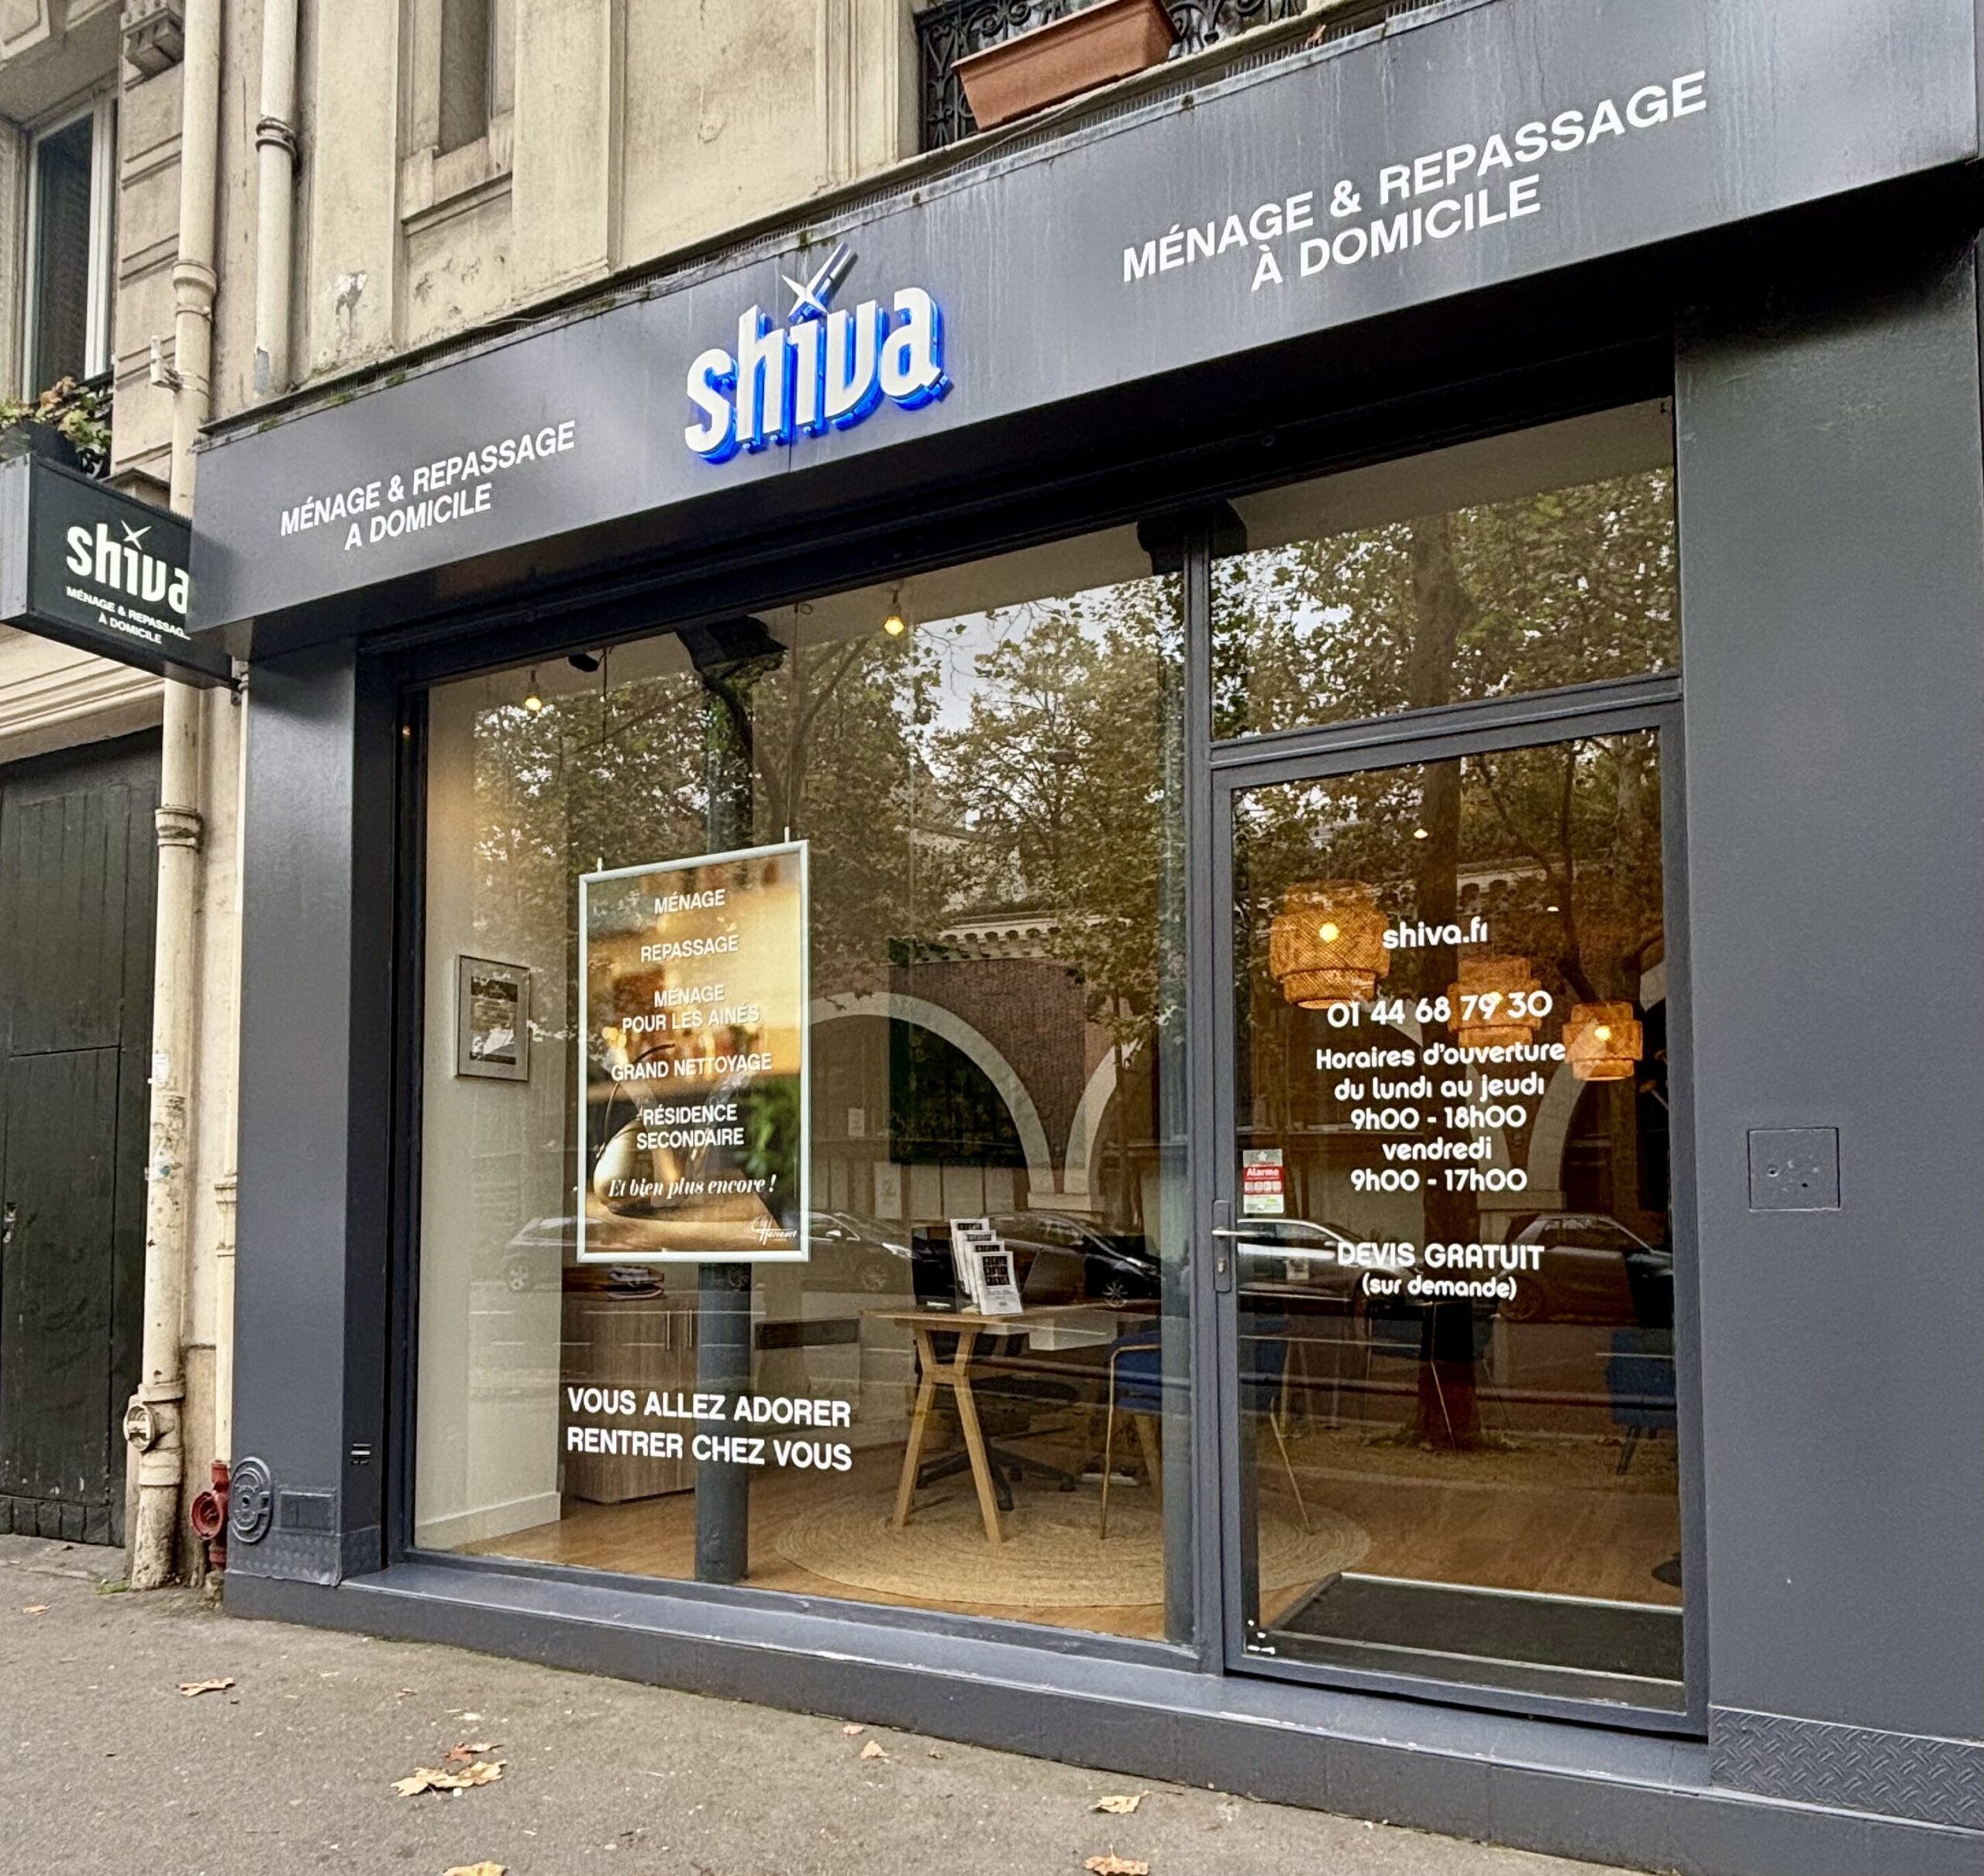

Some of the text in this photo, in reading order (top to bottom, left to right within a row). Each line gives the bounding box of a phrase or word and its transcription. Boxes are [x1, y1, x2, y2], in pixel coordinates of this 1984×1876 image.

[1123, 70, 1707, 283] MÉNAGE & REPASSAGE
[1250, 174, 1541, 291] À DOMICILE
[684, 242, 953, 464] shiva
[280, 420, 576, 536] MÉNAGE & REPASSAGE
[344, 482, 492, 551] A DOMICILE
[66, 520, 189, 614] shiva
[117, 605, 126, 617] &
[109, 617, 162, 645] DOMICILE
[654, 888, 726, 914] MÉNAGE
[1382, 916, 1488, 949] shiva.fr
[640, 935, 739, 962] REPASSAGE
[653, 983, 725, 1007] MÉNAGE
[1327, 990, 1553, 1028] 01 44 68 79 30
[622, 1014, 666, 1034] POUR
[672, 1010, 703, 1029] LES
[611, 1053, 773, 1082] GRAND NETTOYAGE
[1316, 1042, 1566, 1069] Horaires d'ouverture
[1334, 1071, 1545, 1102] du lundi au jeudi
[643, 1103, 738, 1126] RÉSIDENCE
[1350, 1107, 1420, 1131] 9h00
[1444, 1105, 1527, 1128] 18h00
[636, 1127, 745, 1150] SECONDAIRE
[1382, 1137, 1493, 1161] vendredi
[608, 1174, 777, 1200] Et bien plus encore !
[1350, 1169, 1420, 1192] 9h00
[1444, 1168, 1528, 1192] 17h00
[1337, 1241, 1545, 1271] DEVIS GRATUIT
[1362, 1272, 1517, 1300] (sur demande)
[567, 1387, 852, 1428] VOUS ALLEZ ADORER
[567, 1427, 852, 1472] RENTRER CHEZ VOUS
